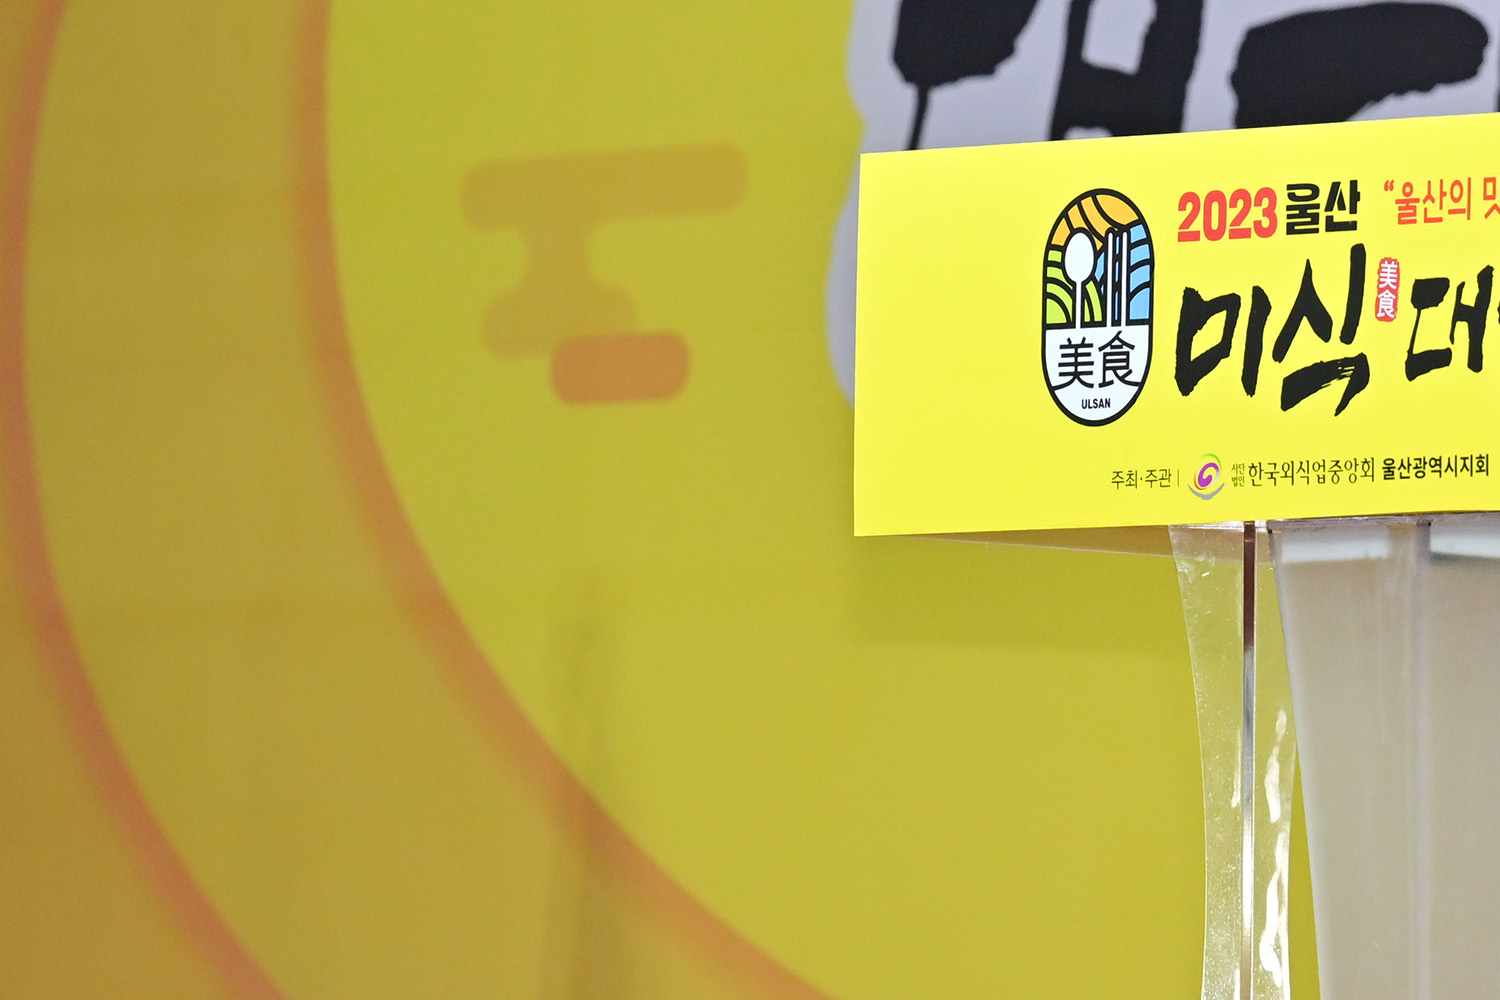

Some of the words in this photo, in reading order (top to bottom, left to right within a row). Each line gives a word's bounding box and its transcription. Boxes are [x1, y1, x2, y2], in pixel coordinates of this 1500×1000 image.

[1178, 187, 1278, 242] 2023
[1286, 179, 1361, 236] 울산
[1376, 260, 1399, 319] 美食
[1174, 243, 1370, 417] 미식
[1052, 330, 1140, 391] 美食
[1081, 398, 1111, 410] ULSAN
[1248, 456, 1376, 487] 한국외식업중앙회
[1381, 453, 1490, 480] 울산광역시지회
